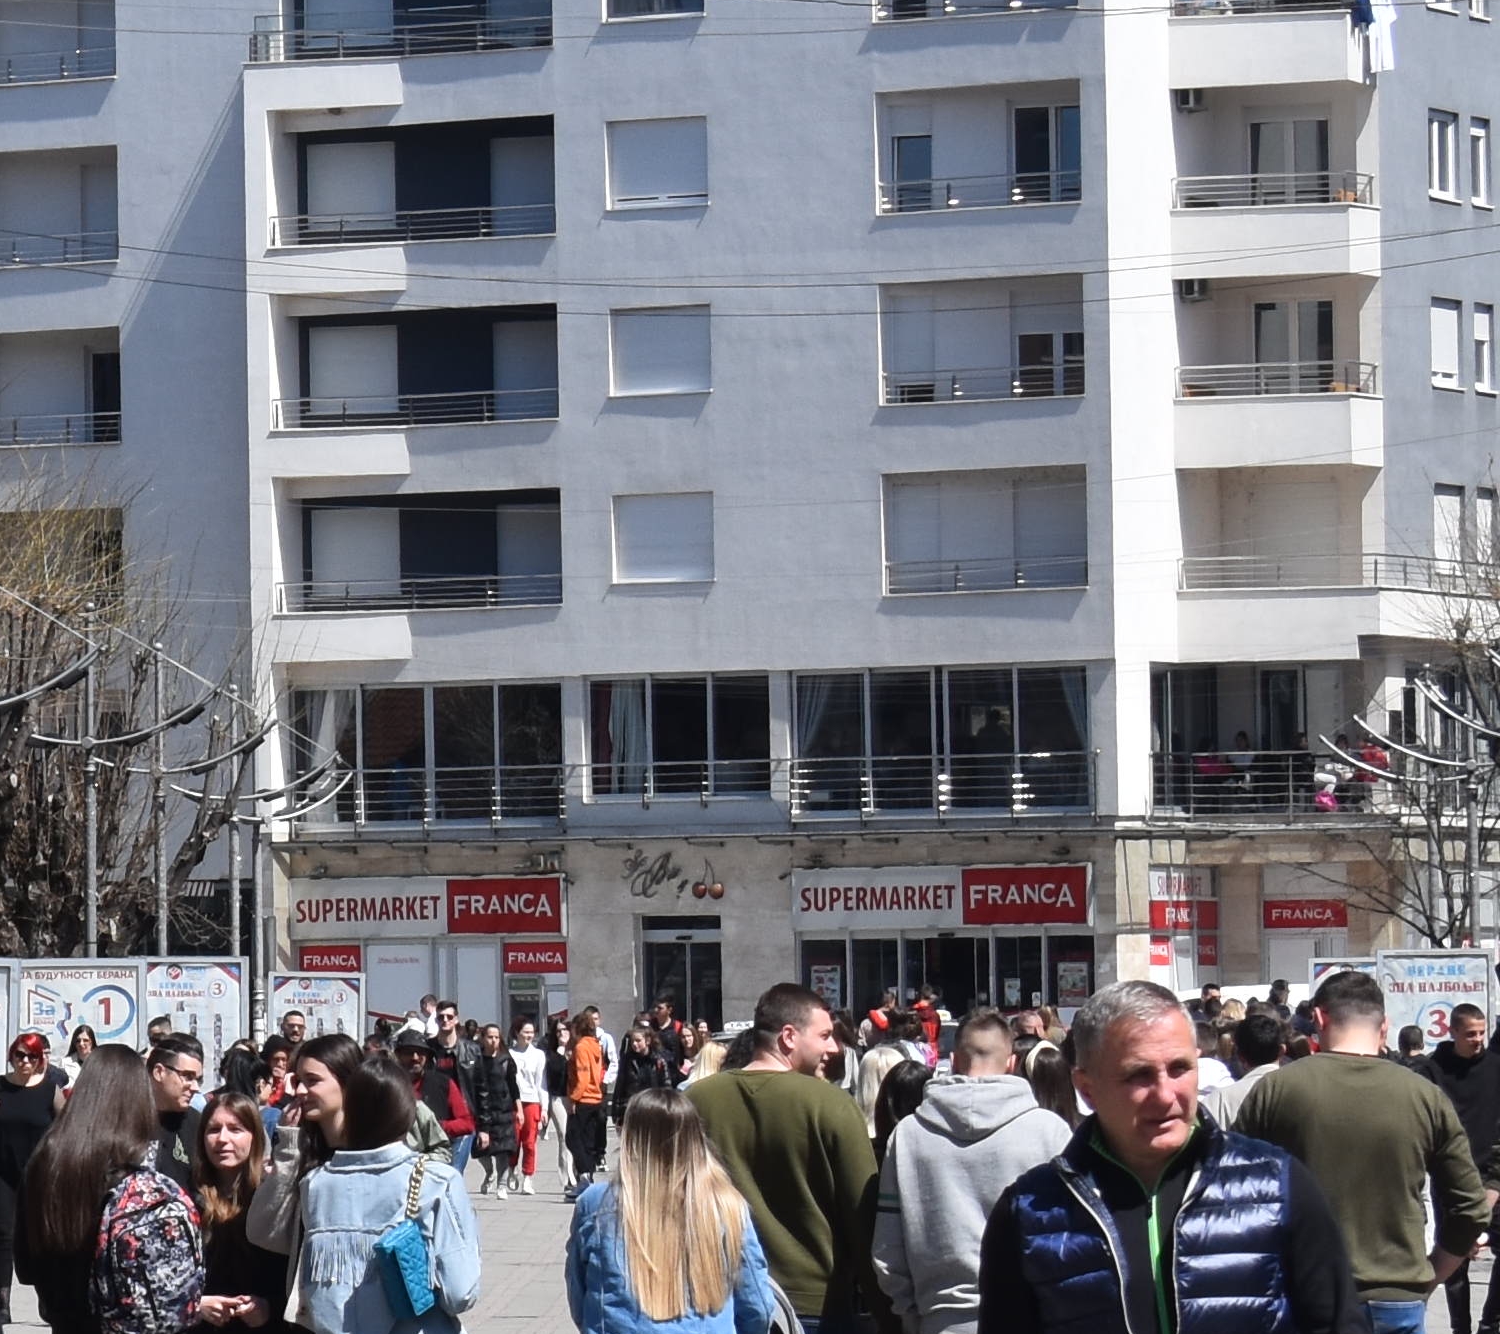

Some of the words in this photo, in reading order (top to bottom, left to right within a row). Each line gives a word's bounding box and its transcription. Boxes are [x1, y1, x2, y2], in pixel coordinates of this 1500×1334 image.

[800, 884, 956, 913] SUPERMARKET
[969, 883, 1076, 910] FRANCA
[295, 895, 441, 924] SUPERMARKET
[453, 892, 553, 919] FRANCA
[1271, 908, 1334, 921] FRANCA
[303, 954, 358, 968] FRANCA
[507, 951, 564, 965] FRANCA
[34, 971, 94, 981] БУДУЋНОСТ
[212, 982, 222, 996] 3
[335, 991, 345, 1004] 3
[97, 996, 112, 1026] 1
[1426, 1009, 1451, 1039] 3
